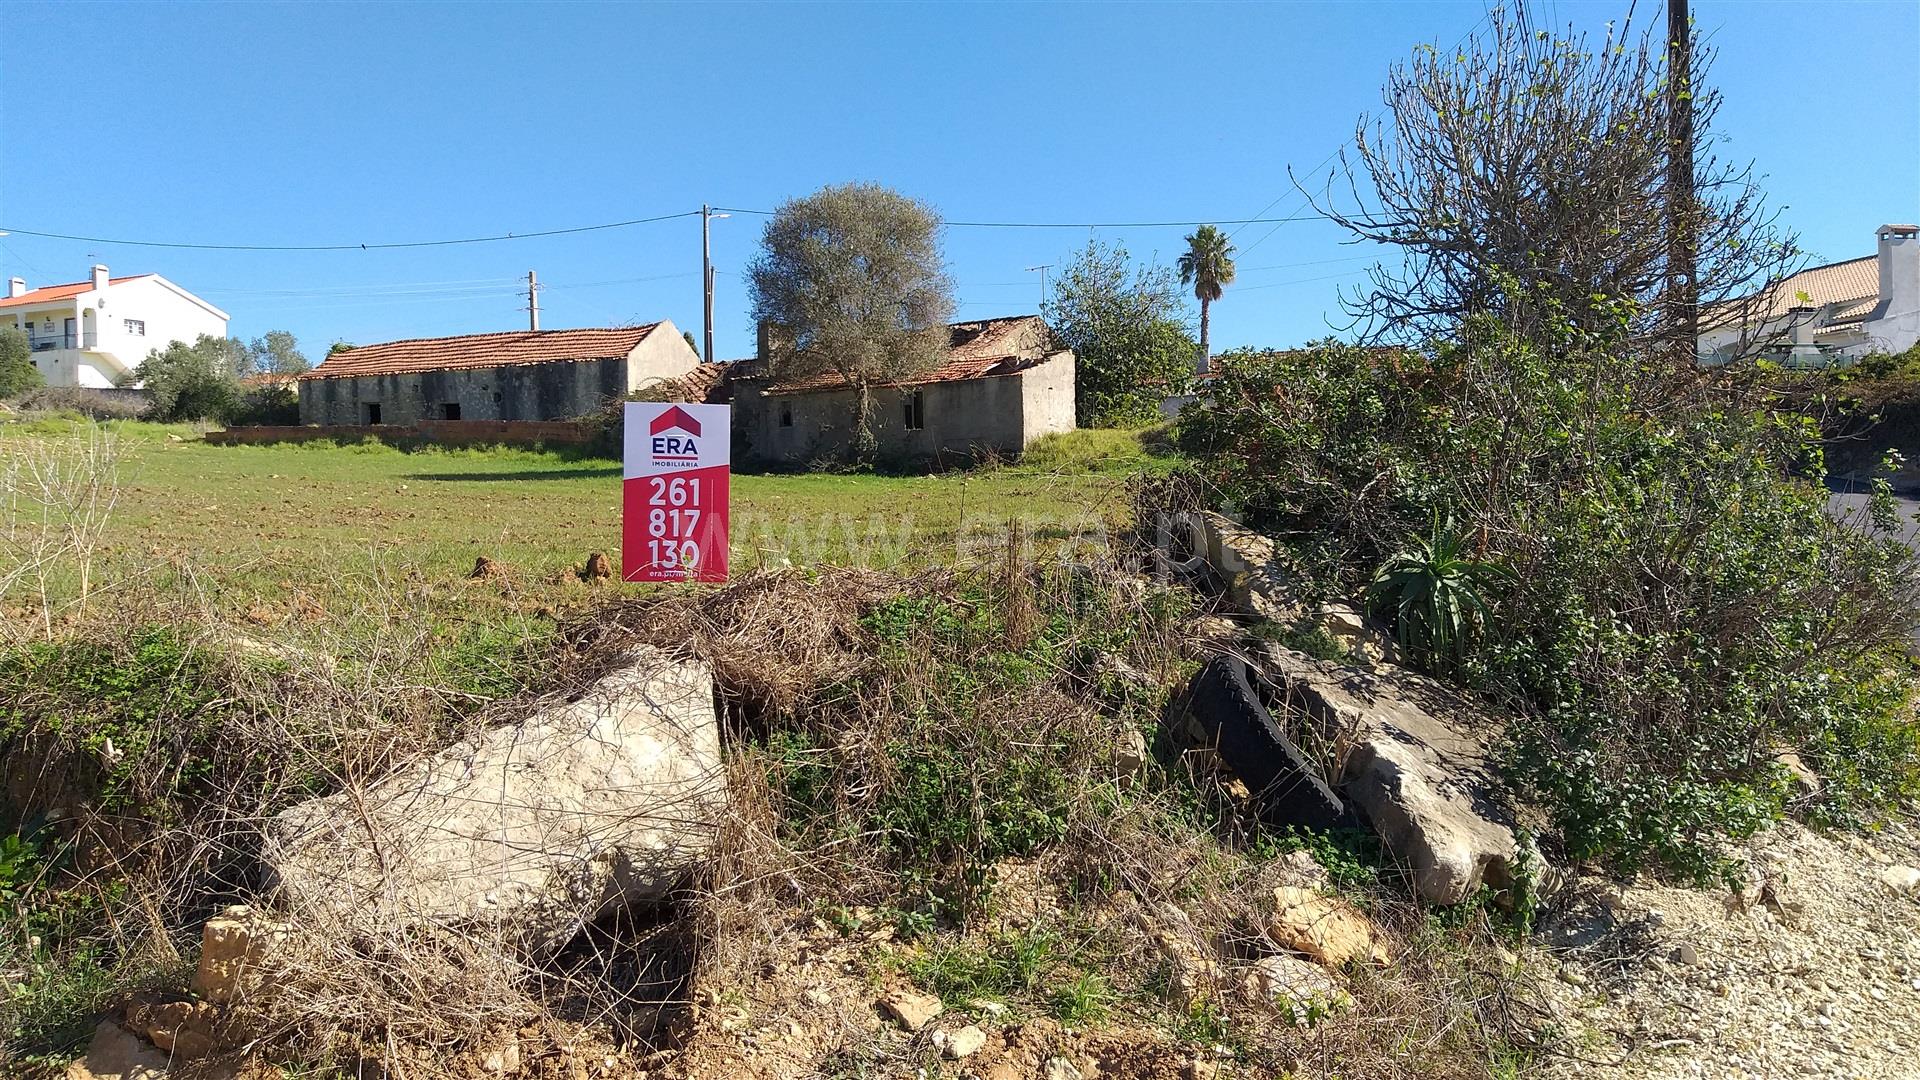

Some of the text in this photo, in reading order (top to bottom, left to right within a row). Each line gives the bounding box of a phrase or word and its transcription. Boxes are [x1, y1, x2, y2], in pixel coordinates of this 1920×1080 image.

[652, 438, 698, 454] ERA
[649, 477, 699, 506] 261
[649, 509, 700, 537] 817
[648, 540, 699, 568] 130
